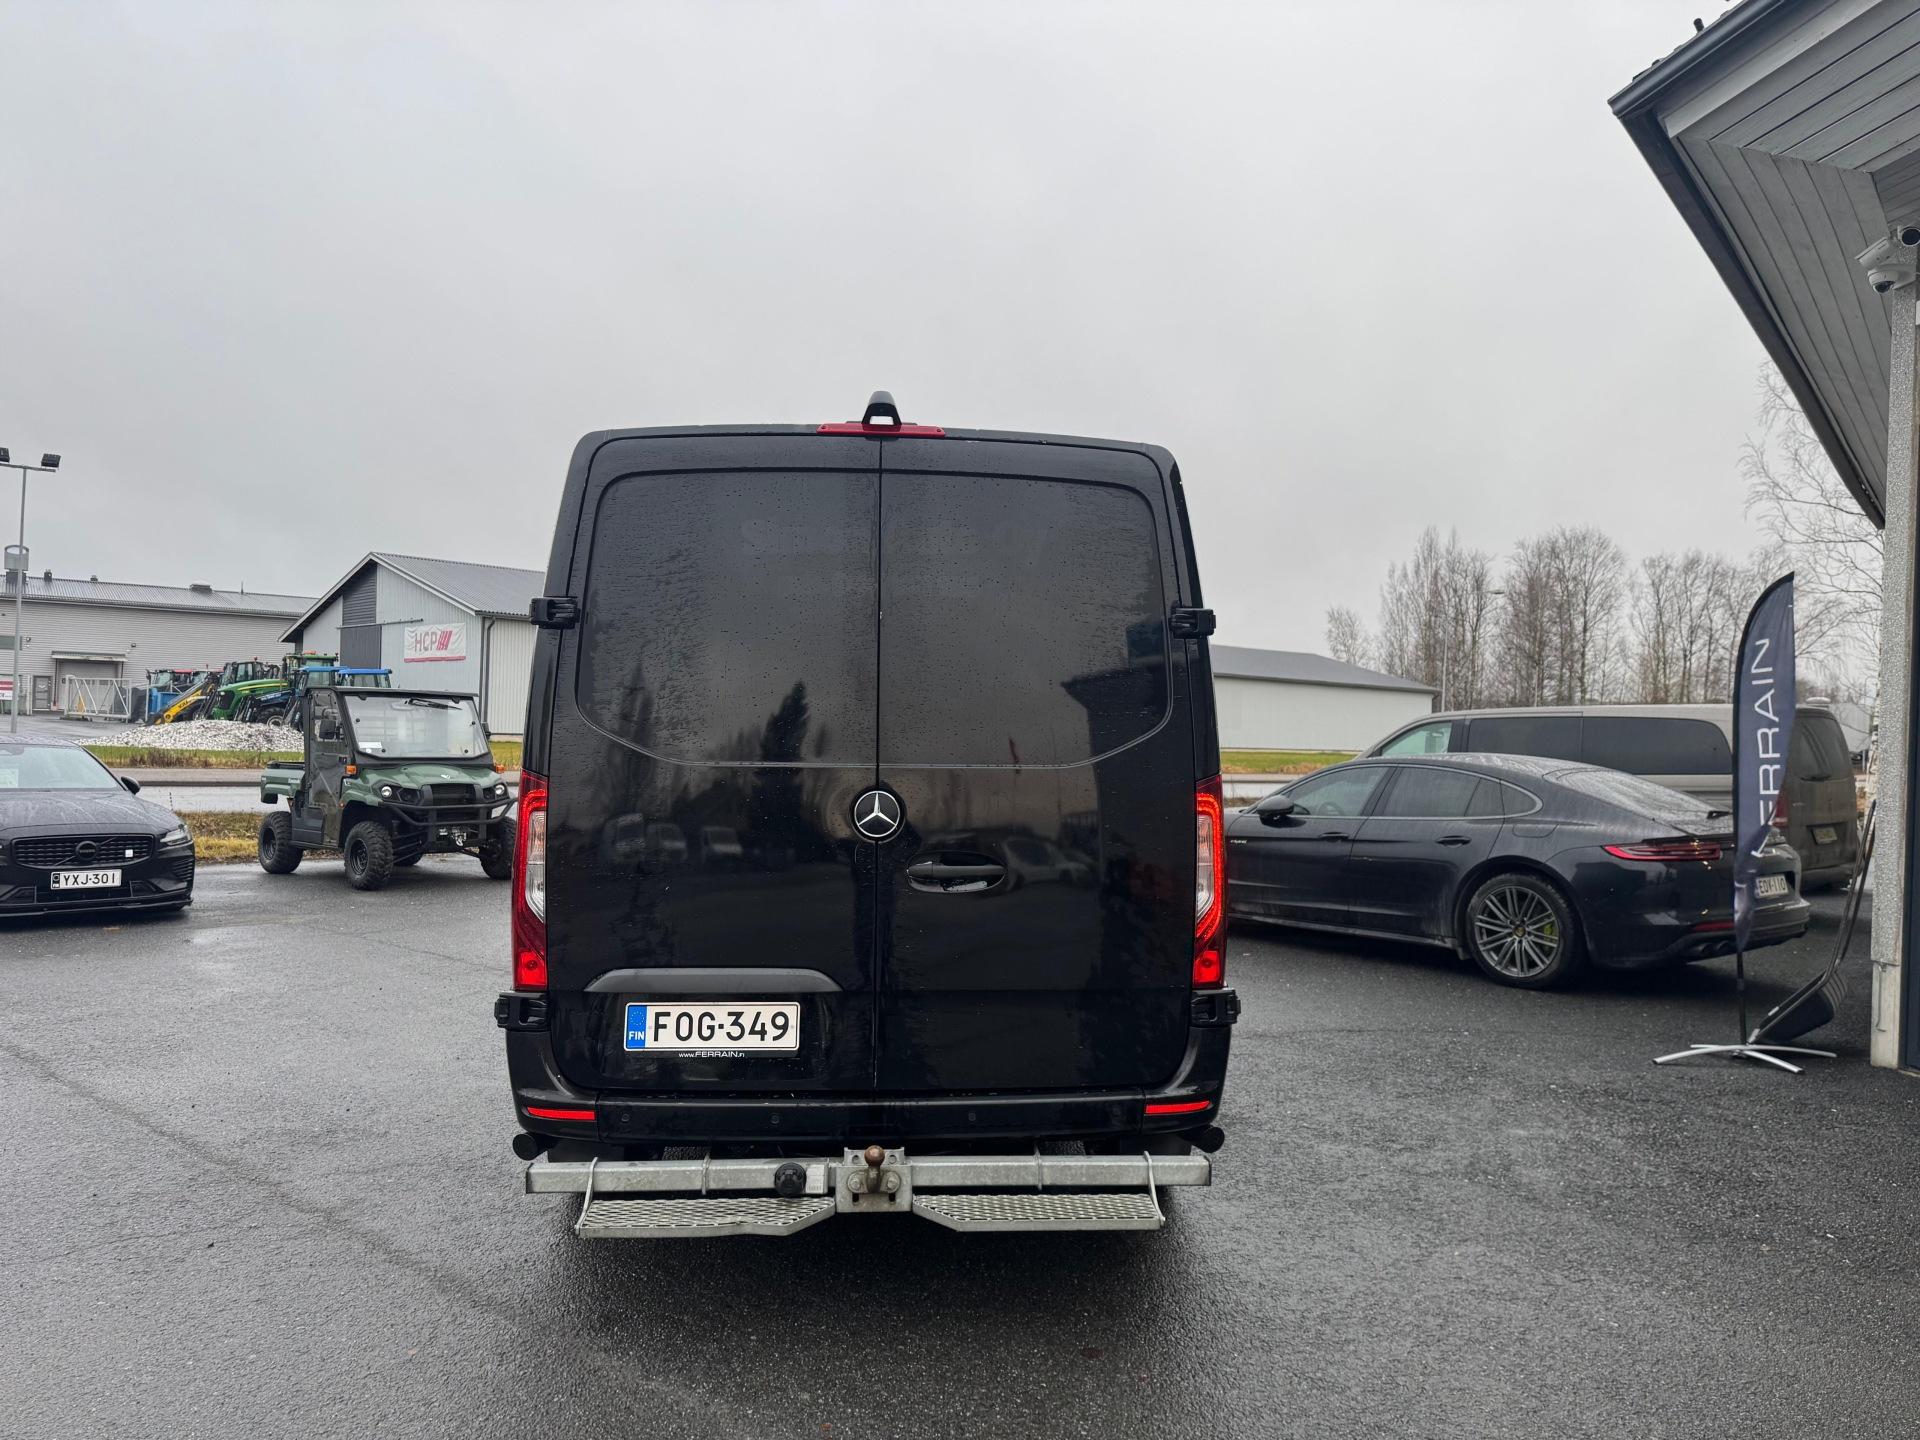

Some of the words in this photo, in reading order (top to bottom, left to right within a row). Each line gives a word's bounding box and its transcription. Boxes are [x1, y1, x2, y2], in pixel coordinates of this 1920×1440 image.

[414, 631, 438, 652] HCP
[63, 873, 115, 886] YXJ-301
[653, 1011, 789, 1042] FOG-349
[628, 1030, 645, 1041] FIN
